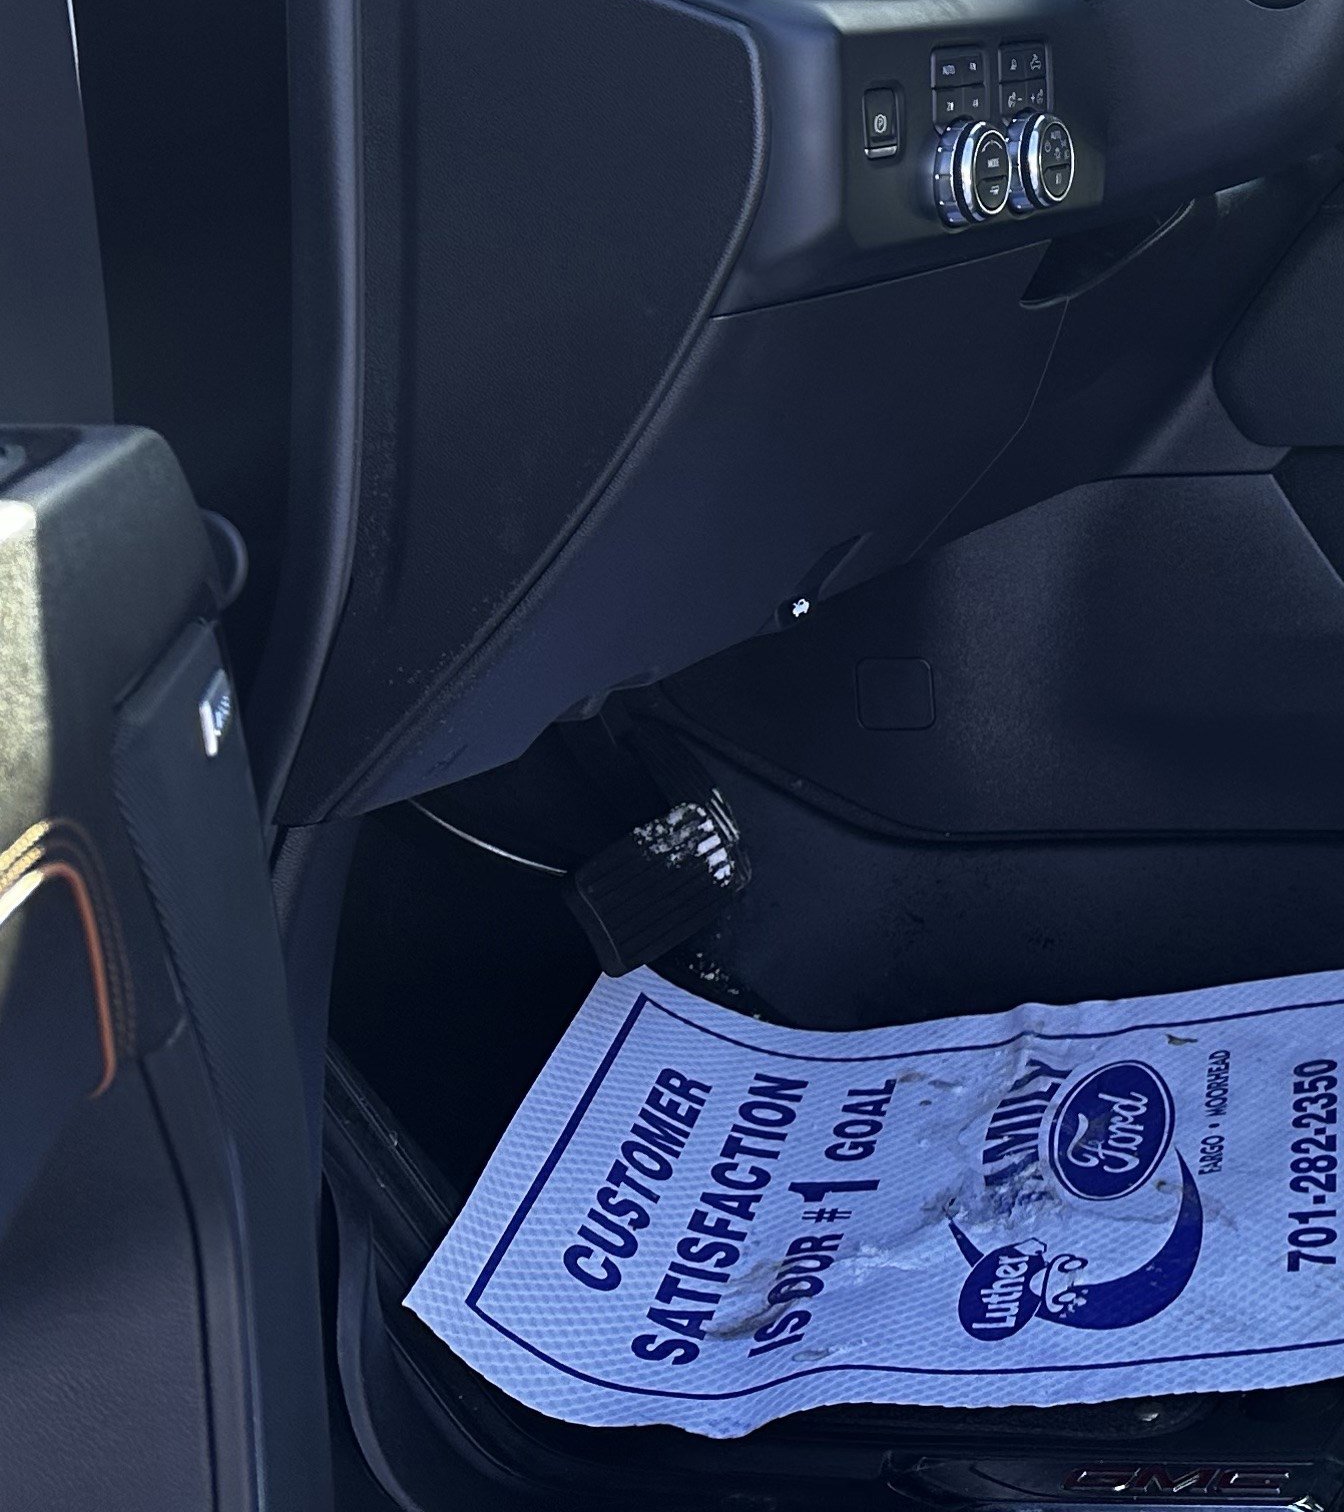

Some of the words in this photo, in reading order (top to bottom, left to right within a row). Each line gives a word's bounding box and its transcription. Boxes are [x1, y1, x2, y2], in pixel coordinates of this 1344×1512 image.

[825, 1079, 896, 1162] GOAL
[1204, 1050, 1231, 1117] MOORHEAD
[1066, 1091, 1149, 1173] Ford
[1198, 1134, 1226, 1175] FARGO
[1287, 1059, 1338, 1272] 701-282-2350
[563, 1067, 712, 1291] CUSTOMER
[631, 1073, 809, 1366] SATISFACTION
[767, 1233, 844, 1305] OUR
[971, 1255, 1029, 1329] Luther
[748, 1310, 812, 1358] IS
